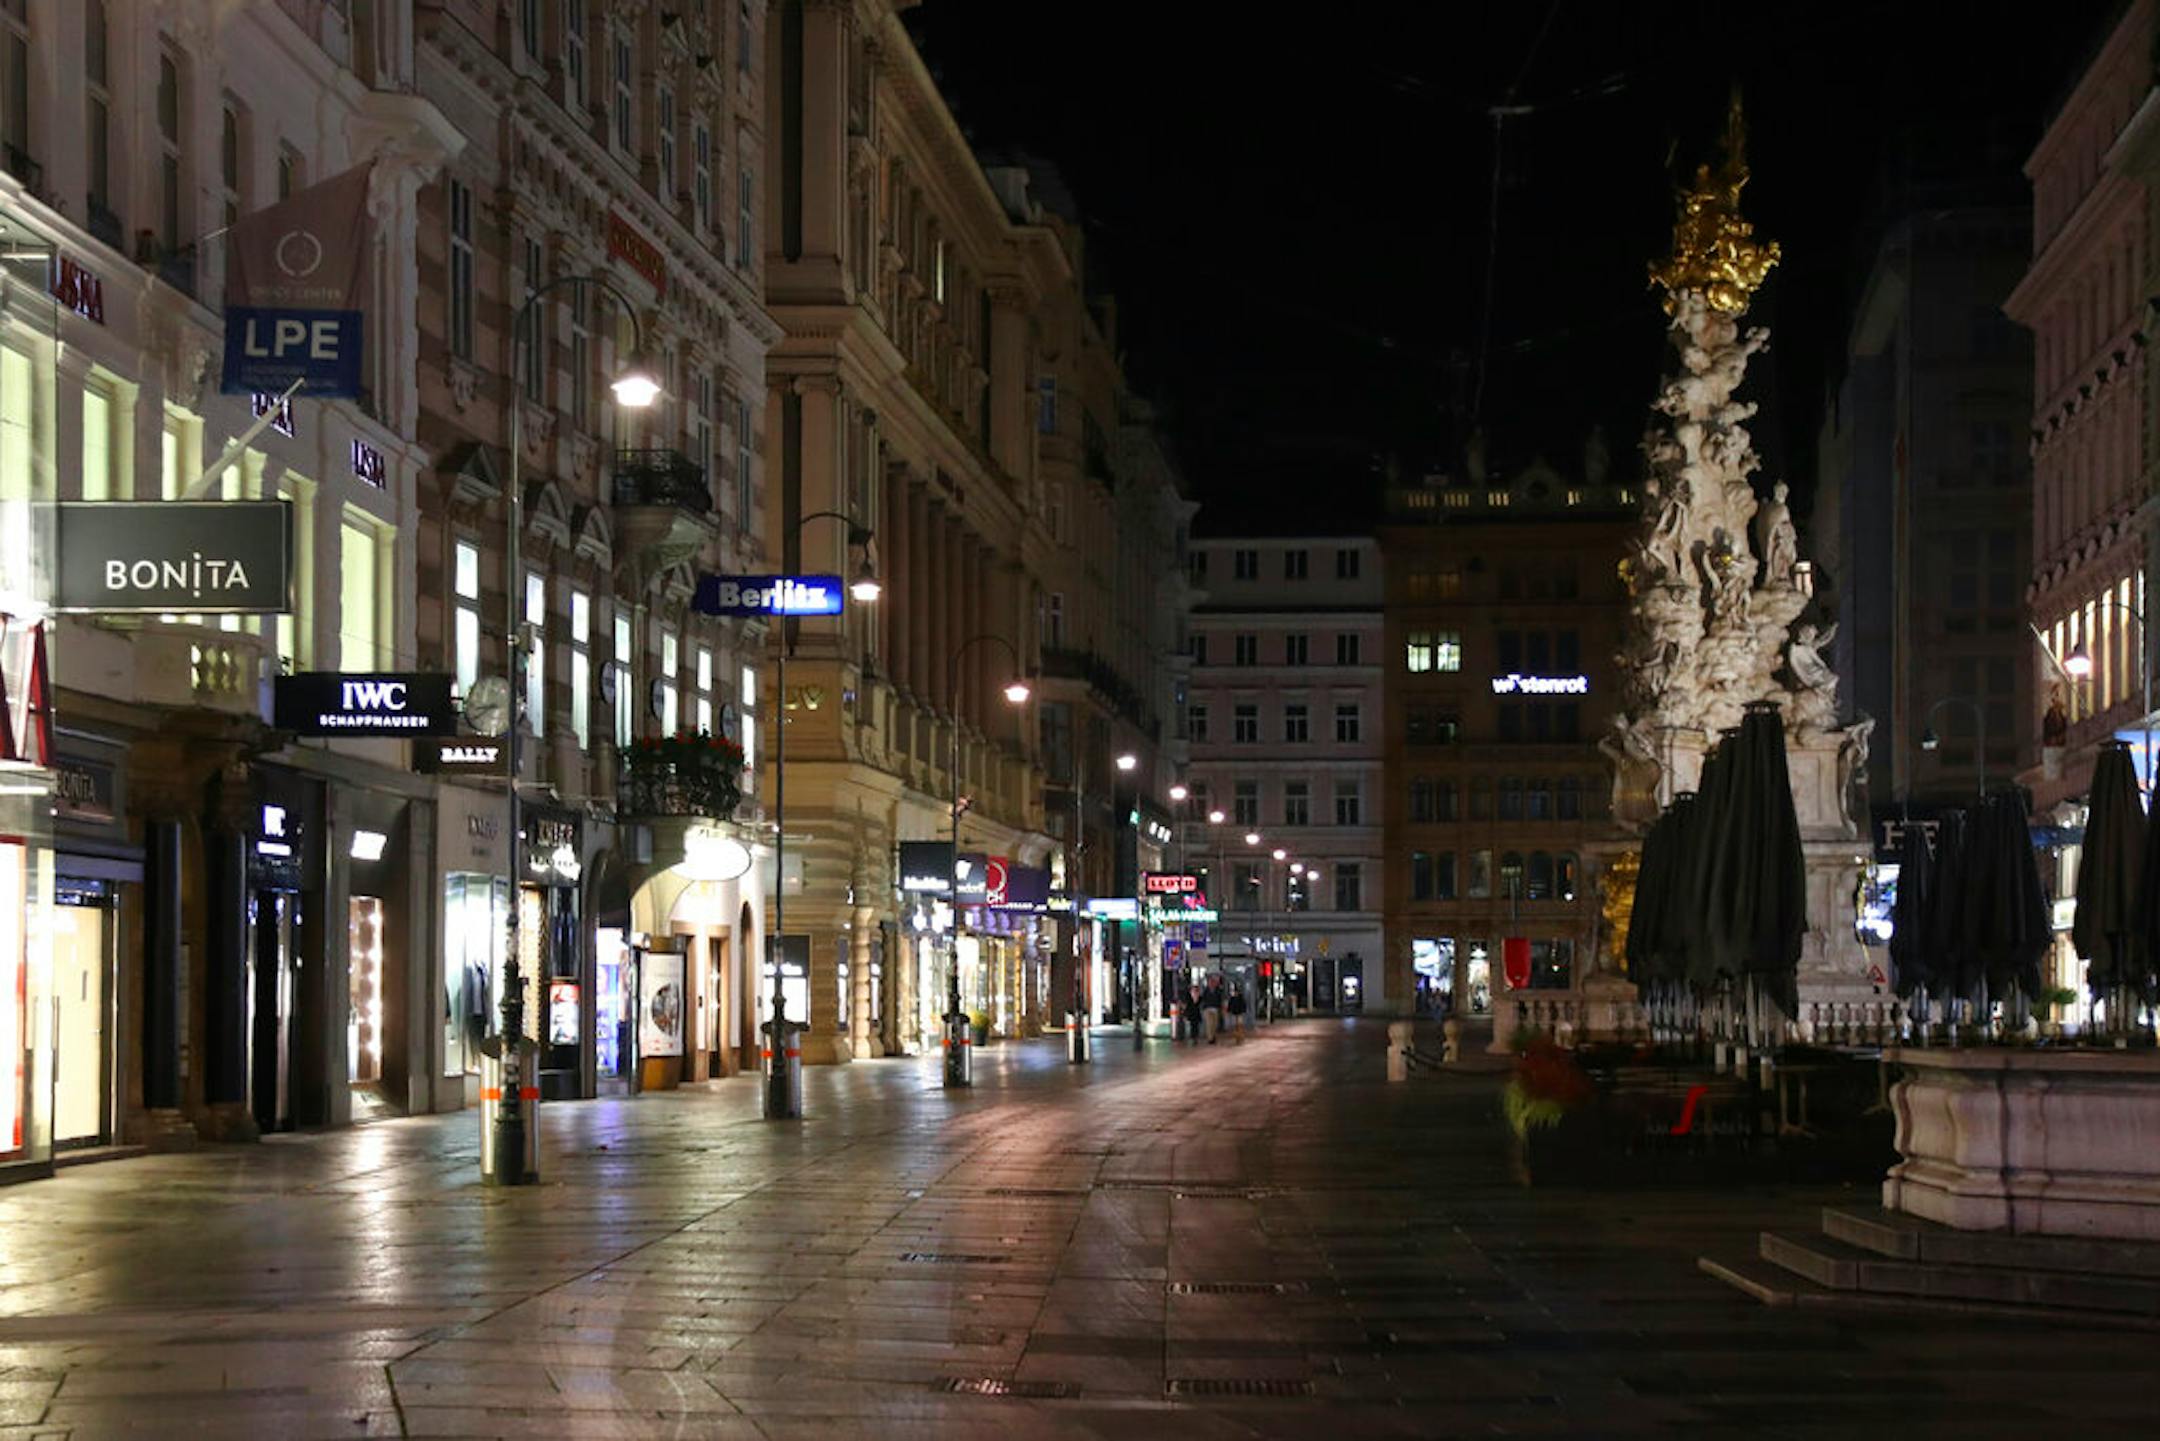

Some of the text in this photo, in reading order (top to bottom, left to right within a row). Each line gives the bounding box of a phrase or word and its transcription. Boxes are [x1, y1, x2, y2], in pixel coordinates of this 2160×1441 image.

[244, 318, 340, 359] LPE
[718, 579, 828, 609] Berlitz
[342, 682, 407, 711] IWC
[319, 714, 429, 728] SCHAFFHAUSEN
[440, 747, 499, 763] BALLY
